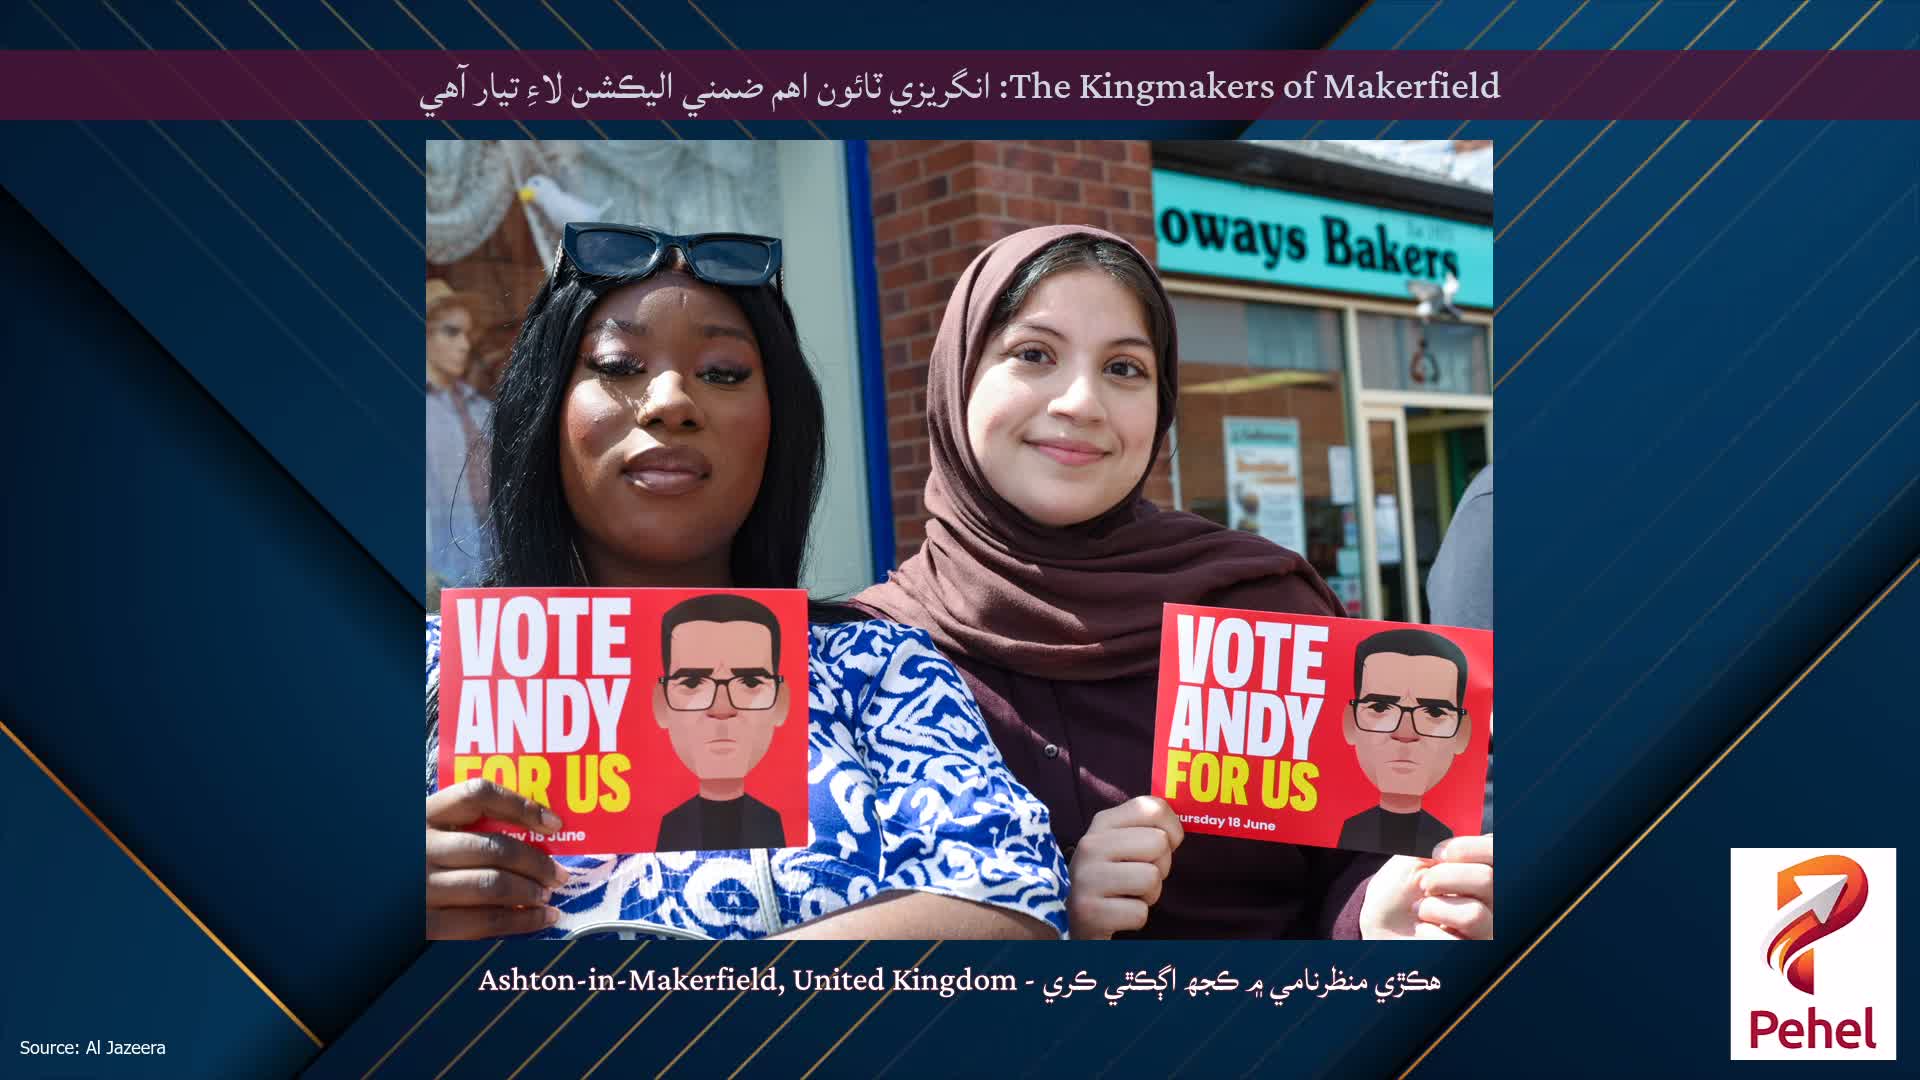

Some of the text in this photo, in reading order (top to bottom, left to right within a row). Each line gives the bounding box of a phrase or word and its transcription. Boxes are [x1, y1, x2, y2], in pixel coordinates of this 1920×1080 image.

[1158, 206, 1460, 279] oways Bakers
[456, 596, 632, 677] VOTE
[1176, 614, 1330, 695] VOTE
[454, 678, 631, 754] ANDY
[1167, 685, 1324, 761] ANDY
[566, 753, 632, 814] US
[1164, 749, 1320, 812] FOR US
[547, 830, 586, 842] June
[1175, 813, 1277, 831] ursday 18 June
